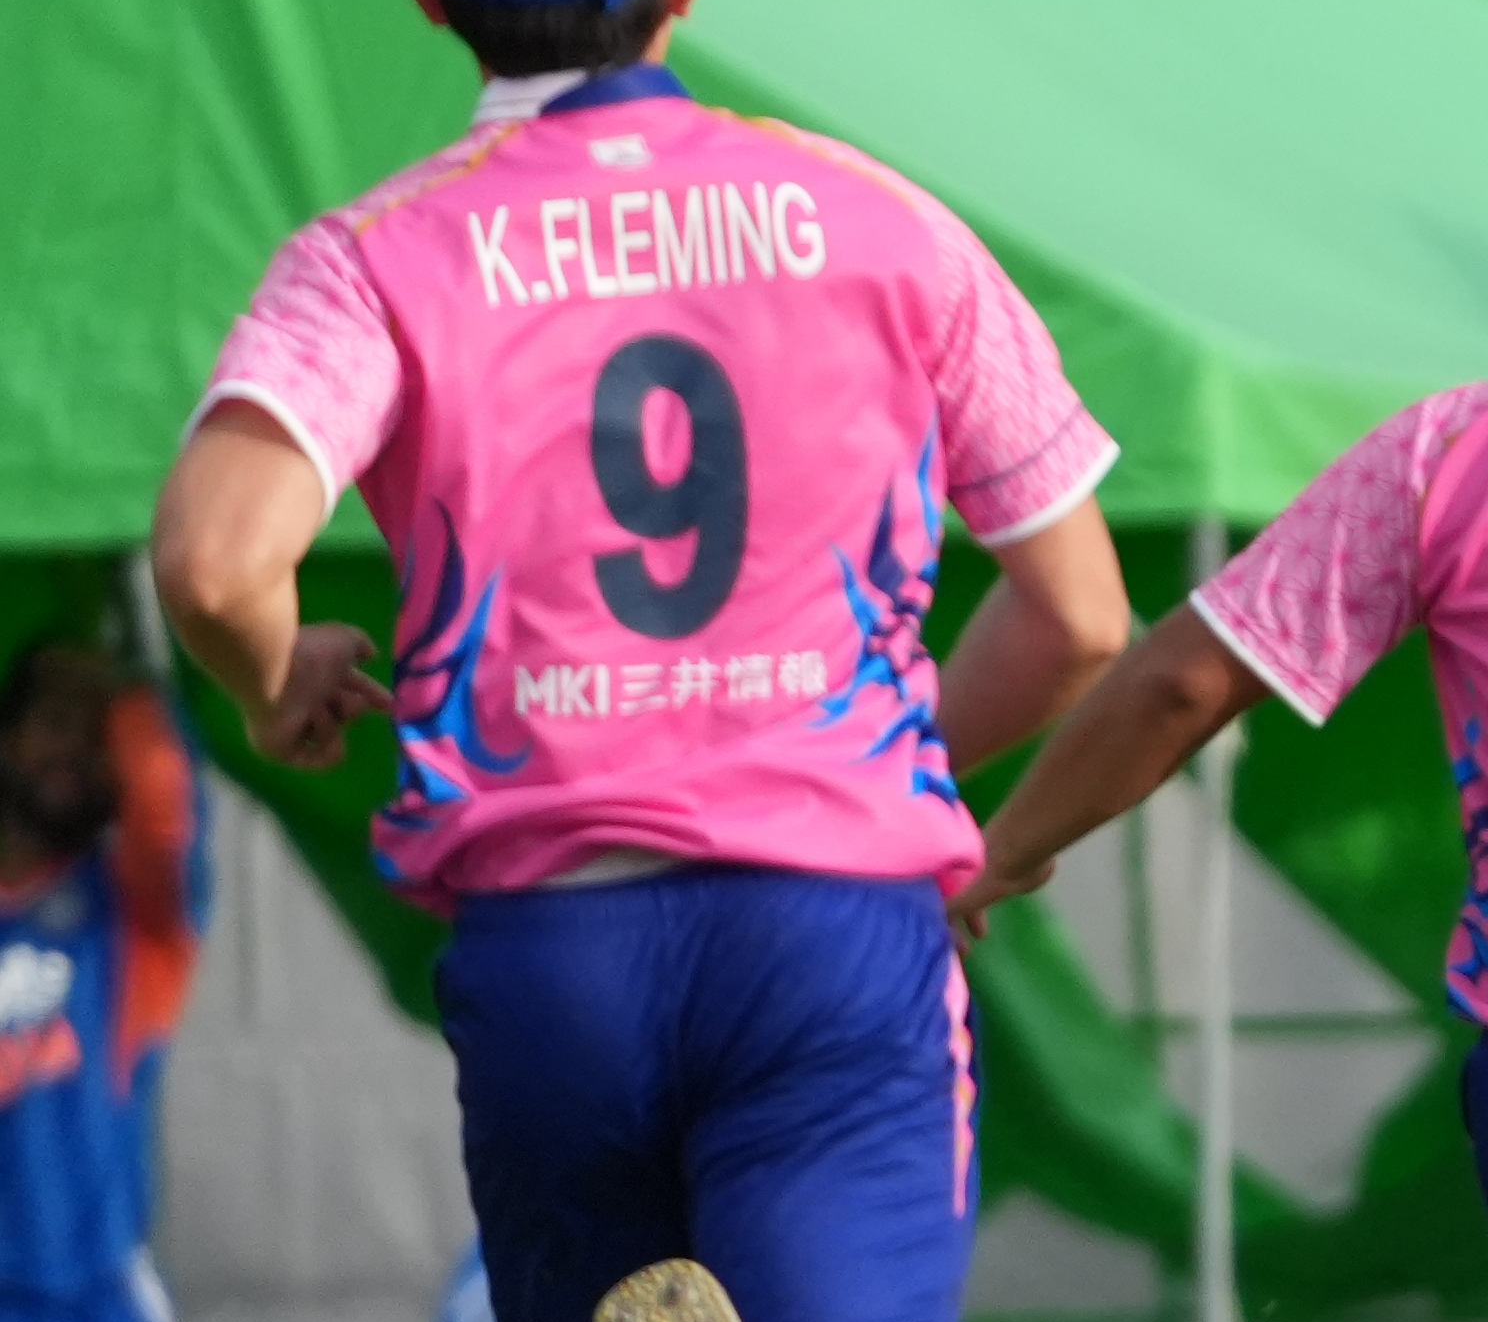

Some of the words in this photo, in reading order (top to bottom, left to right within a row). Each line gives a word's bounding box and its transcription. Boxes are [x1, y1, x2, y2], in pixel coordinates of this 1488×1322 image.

[468, 180, 828, 309] K.FLEMING
[590, 331, 749, 642] 9
[514, 664, 610, 717] MKI
